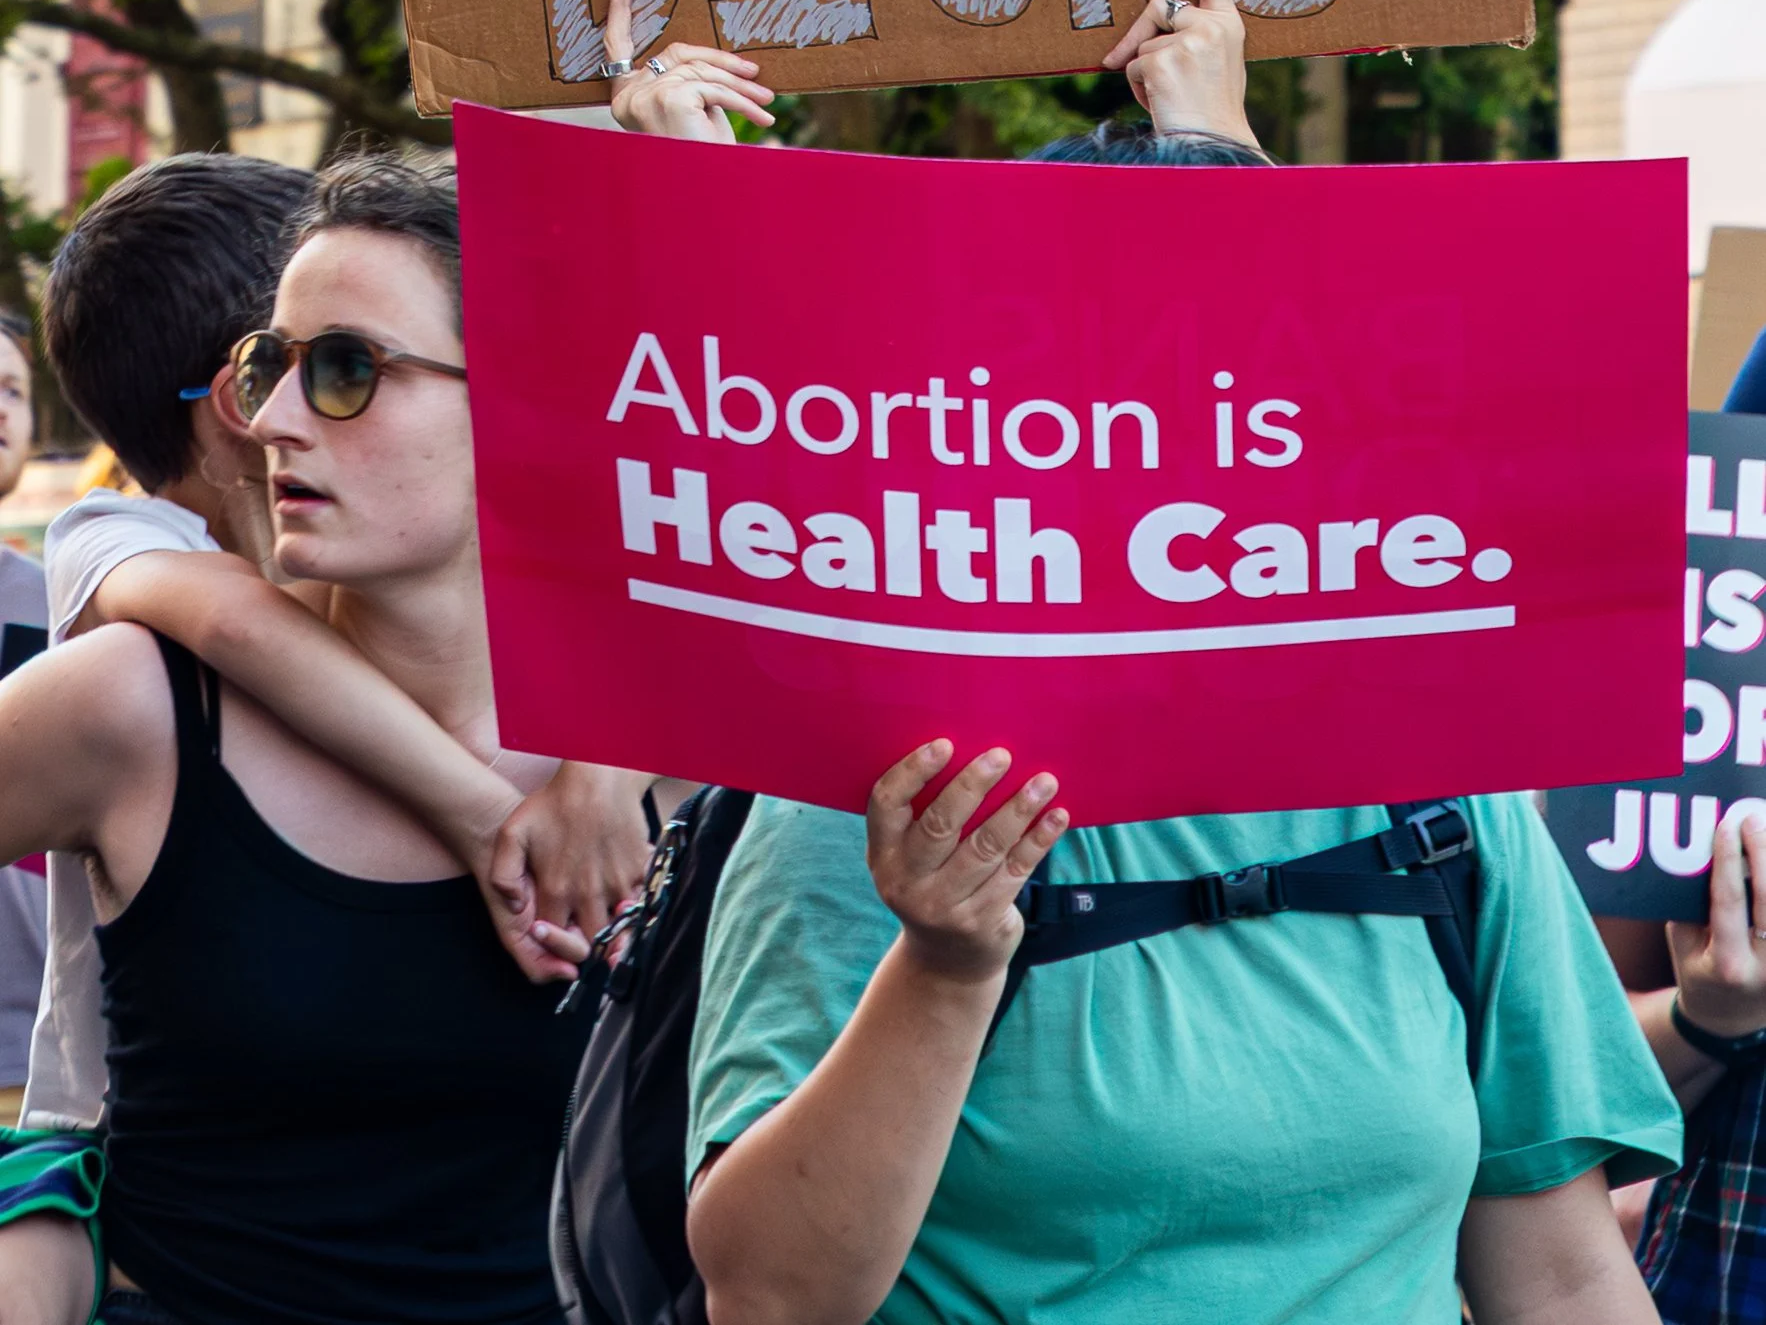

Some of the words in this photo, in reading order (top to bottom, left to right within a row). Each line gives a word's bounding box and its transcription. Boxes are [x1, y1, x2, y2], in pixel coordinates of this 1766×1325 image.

[606, 331, 1160, 470] Abortion
[1212, 370, 1303, 468] is
[616, 456, 1083, 604] Health
[1126, 500, 1513, 603] Care.
